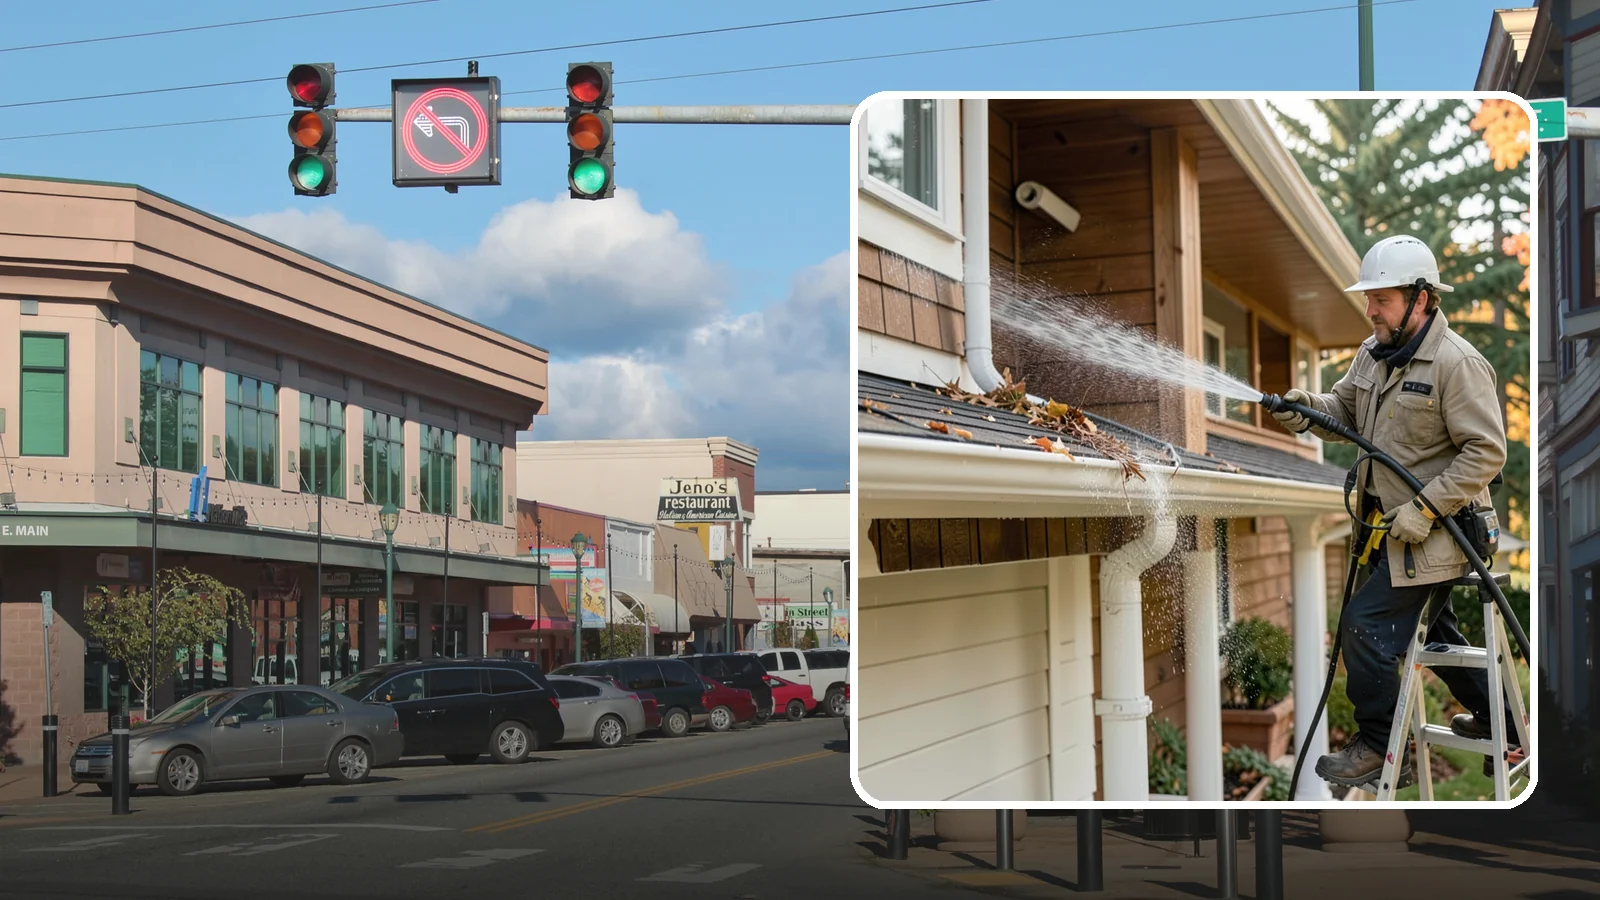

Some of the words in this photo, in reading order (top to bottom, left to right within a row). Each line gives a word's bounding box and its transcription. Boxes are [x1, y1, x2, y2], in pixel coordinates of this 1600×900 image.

[669, 479, 728, 494] Jeno's
[665, 496, 731, 509] restaurant
[658, 510, 682, 520] Italian
[686, 510, 714, 519] American
[714, 509, 737, 519] Cuisine
[2, 525, 13, 536] E.
[15, 525, 49, 536] MAIN
[797, 607, 828, 617] Street
